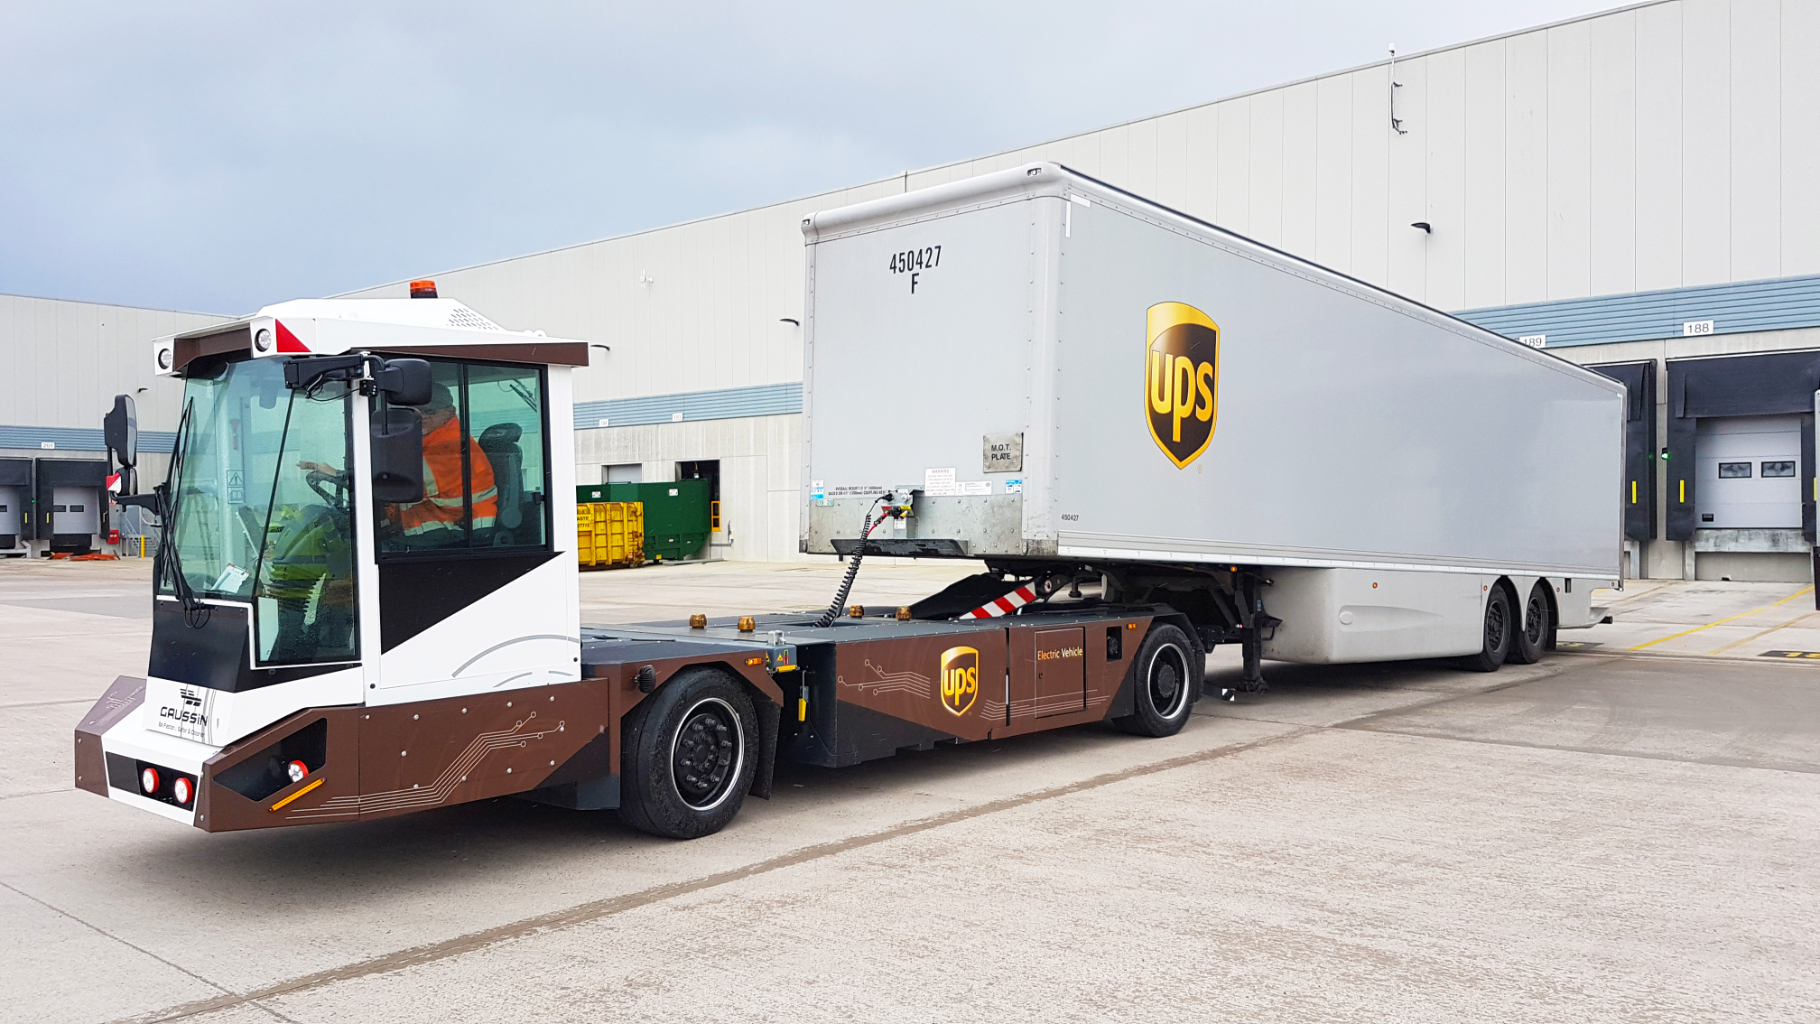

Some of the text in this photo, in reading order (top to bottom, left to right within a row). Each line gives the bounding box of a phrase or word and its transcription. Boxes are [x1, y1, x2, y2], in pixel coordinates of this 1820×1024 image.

[889, 245, 942, 274] 450427
[911, 272, 920, 294] F
[1687, 322, 1710, 334] 188
[1523, 336, 1542, 348] 189
[1151, 350, 1214, 443] ups
[991, 443, 1012, 452] M.O.T.
[991, 452, 1011, 461] PLATE
[1061, 513, 1079, 521] 450427
[1037, 646, 1083, 660] Electric Vehicle
[943, 666, 976, 706] ups
